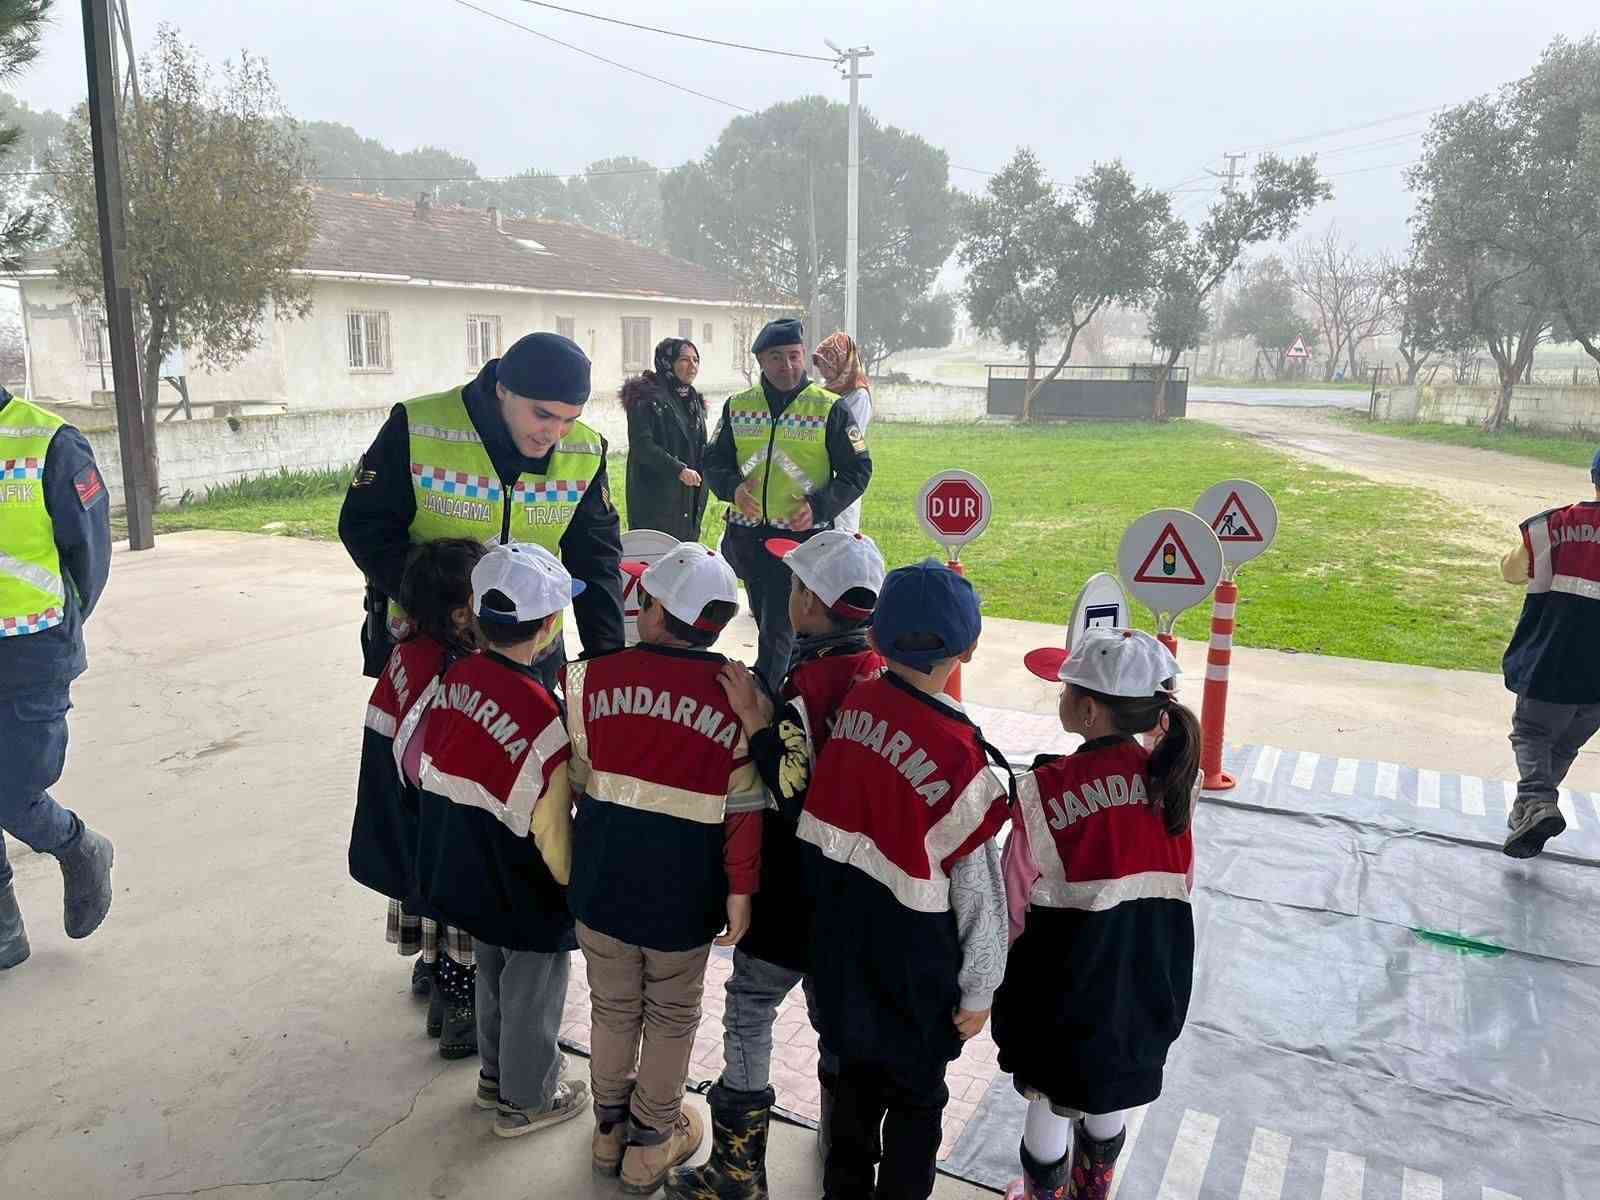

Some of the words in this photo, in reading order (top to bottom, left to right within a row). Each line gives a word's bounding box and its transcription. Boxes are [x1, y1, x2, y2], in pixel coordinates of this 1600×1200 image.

[424, 493, 491, 522] JANDARMA
[525, 506, 574, 524] TRAF
[931, 497, 976, 518] DUR
[430, 682, 529, 764] ANDARMA
[588, 685, 738, 750] JANDARMA
[830, 709, 951, 807] NDARMA
[1048, 773, 1165, 831] JANDA
